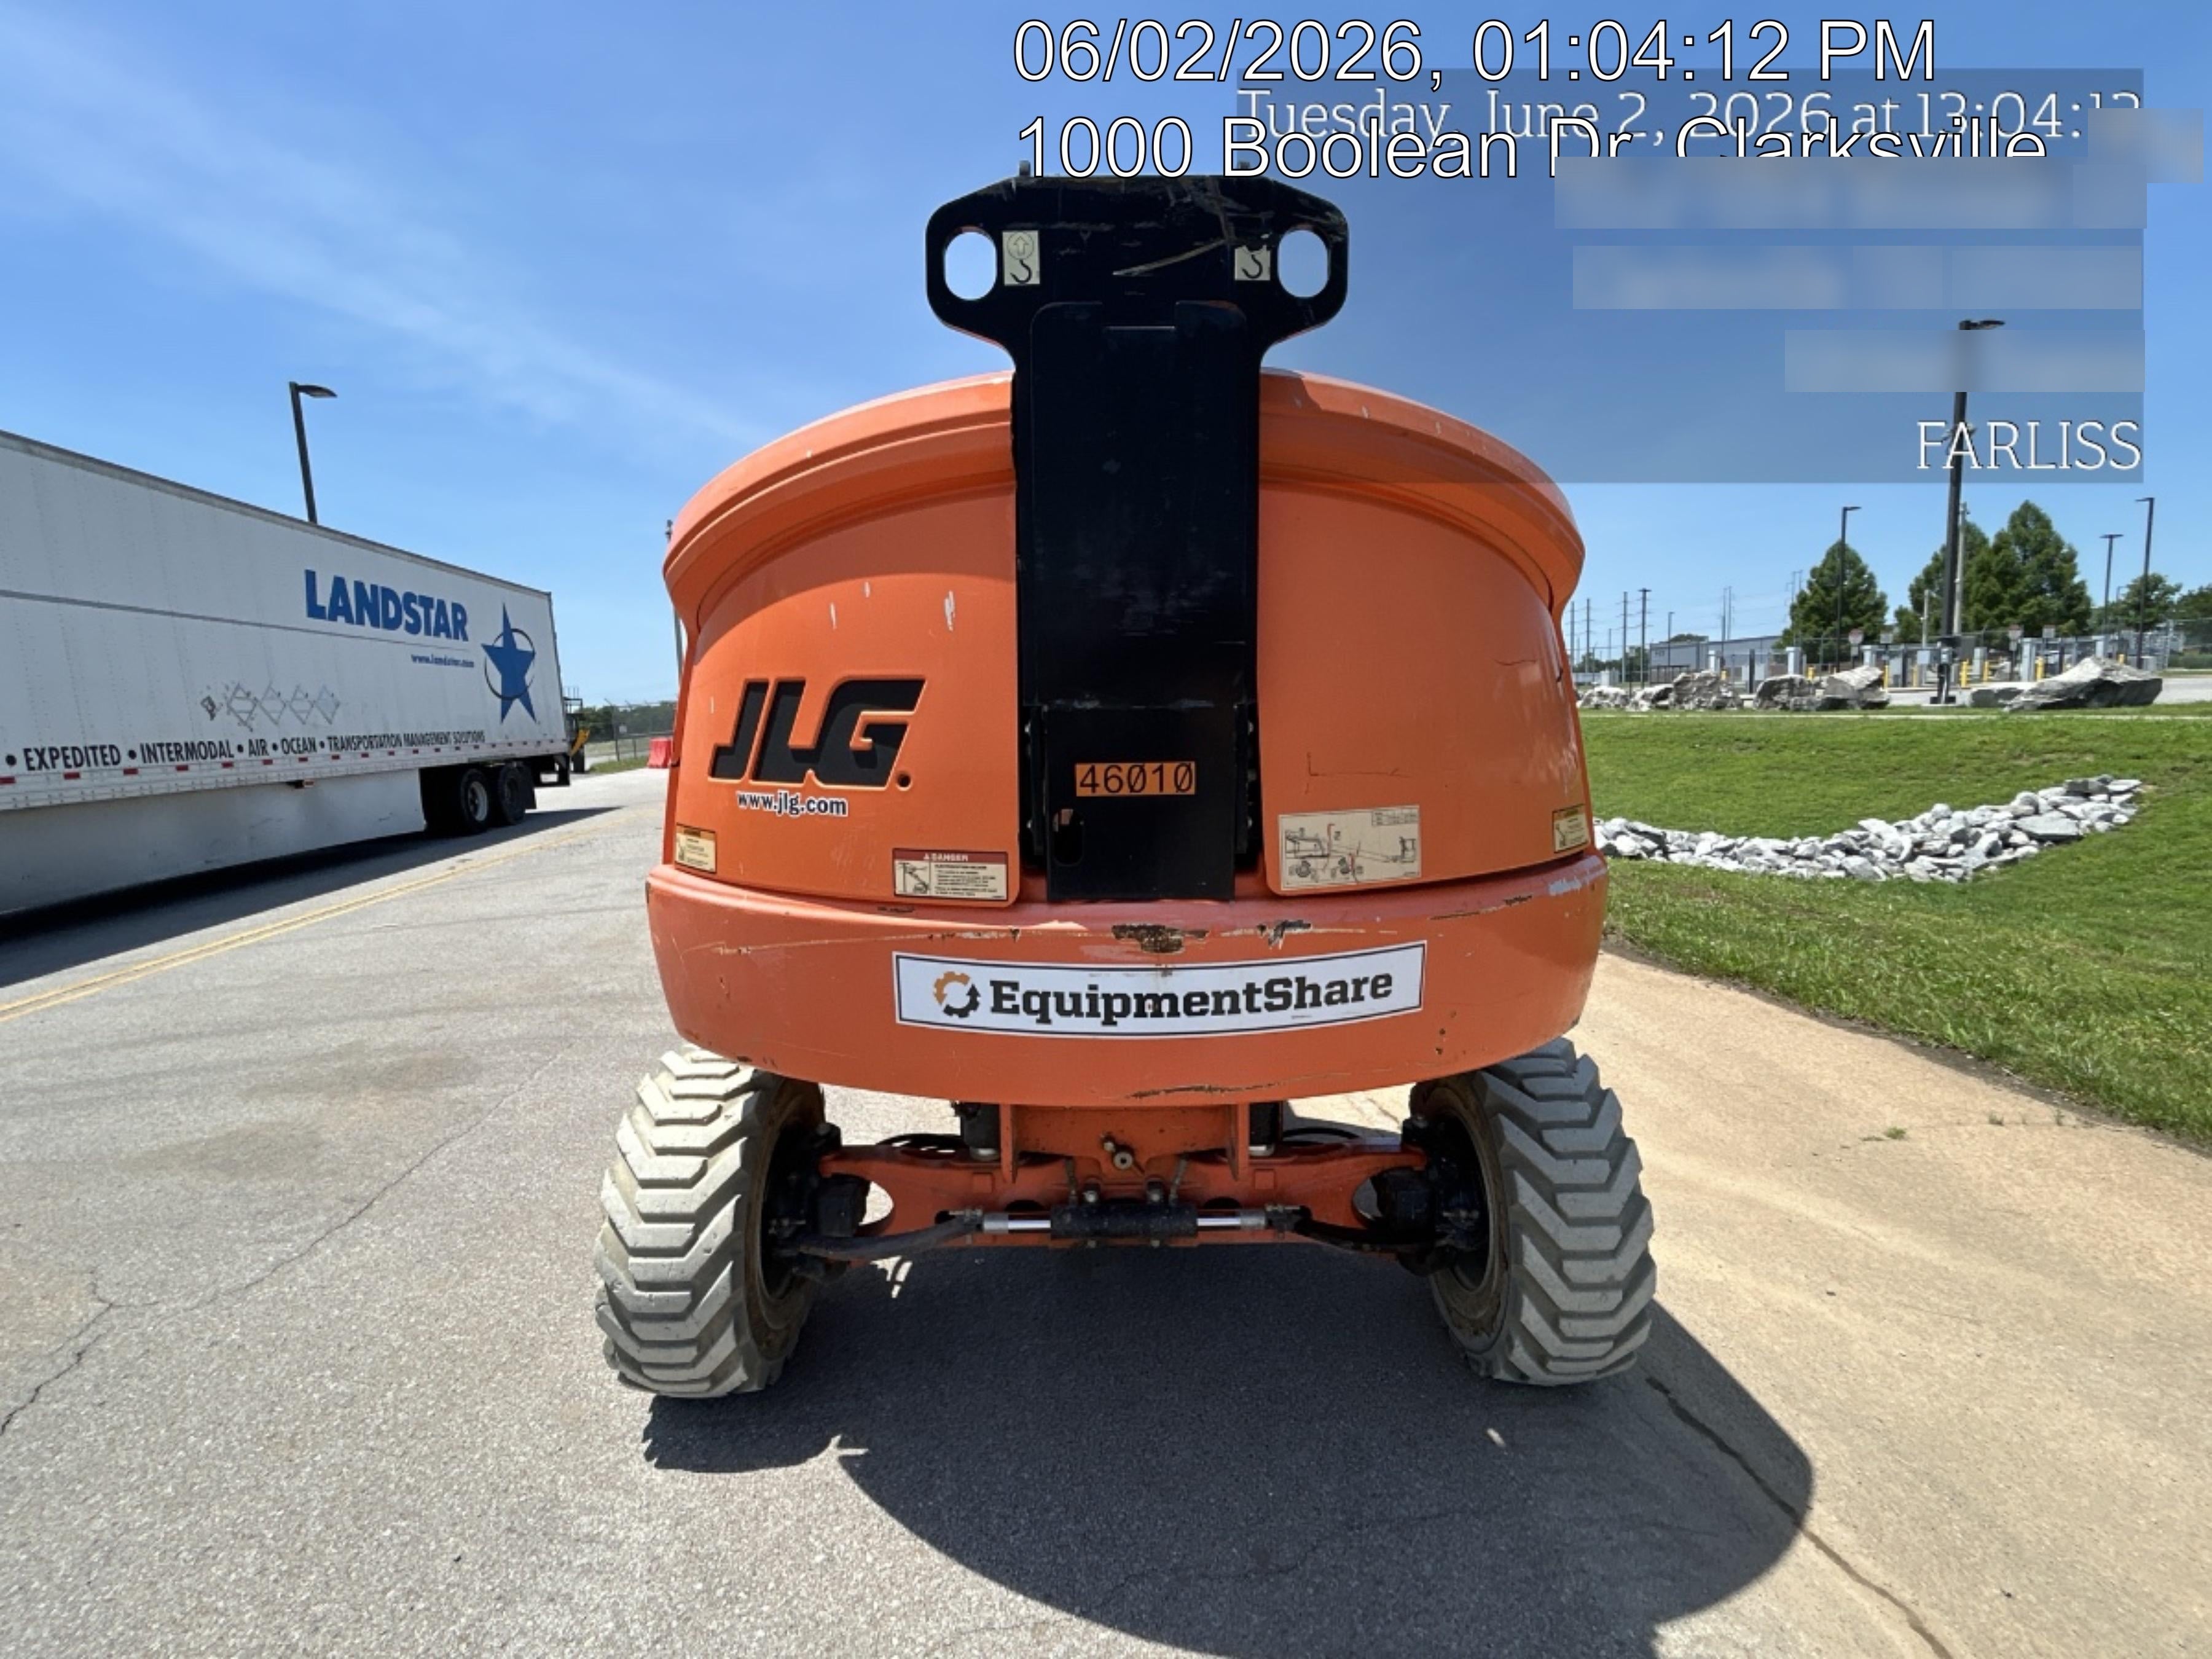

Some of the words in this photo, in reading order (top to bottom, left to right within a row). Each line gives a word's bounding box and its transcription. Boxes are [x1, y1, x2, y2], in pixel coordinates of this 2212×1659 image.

[305, 569, 469, 641] LANDSTAR
[23, 744, 122, 771] EXPEDITED
[139, 740, 235, 763] INTERMODAL
[248, 739, 269, 756] AIR
[281, 737, 318, 755] OCEAN
[326, 732, 402, 752] TRANSPORTATION
[1078, 763, 1193, 794] 46010
[737, 791, 848, 816] www.jlg.com
[990, 973, 1393, 1026] EquipmentShare
